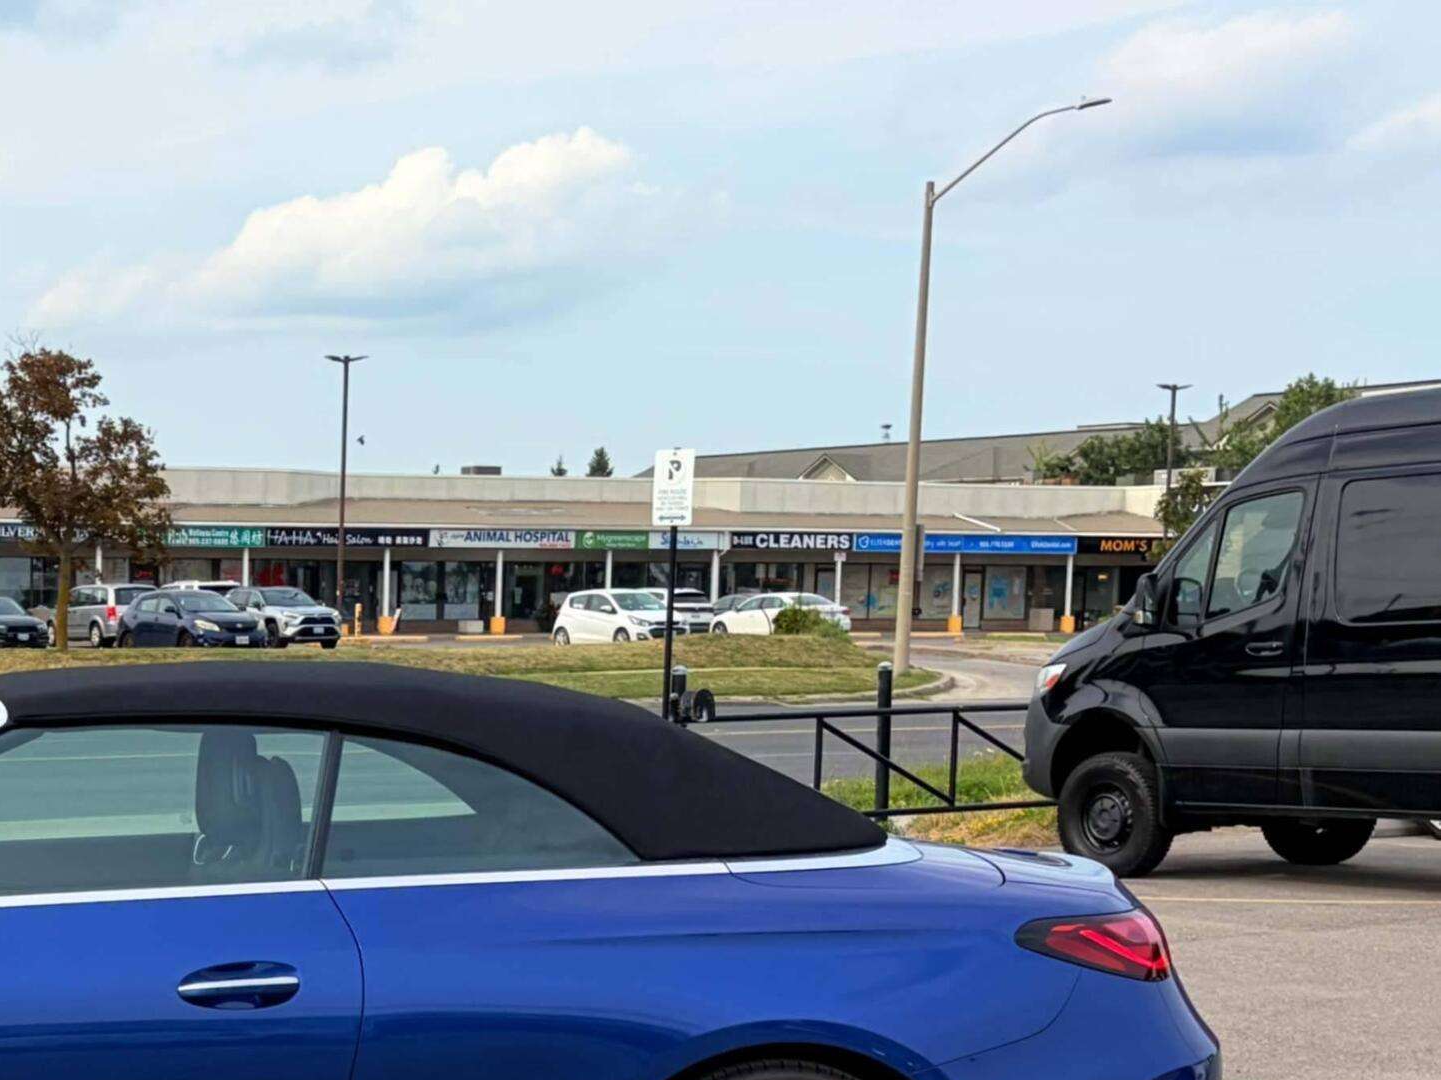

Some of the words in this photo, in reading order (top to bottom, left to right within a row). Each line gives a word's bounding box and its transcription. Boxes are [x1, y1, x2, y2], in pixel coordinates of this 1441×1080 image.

[345, 534, 373, 546] Salon
[464, 531, 512, 542] ANIMAL
[515, 531, 571, 543] HOSPITAL
[755, 533, 850, 549] CLEANERS
[1100, 539, 1148, 551] MOM'S
